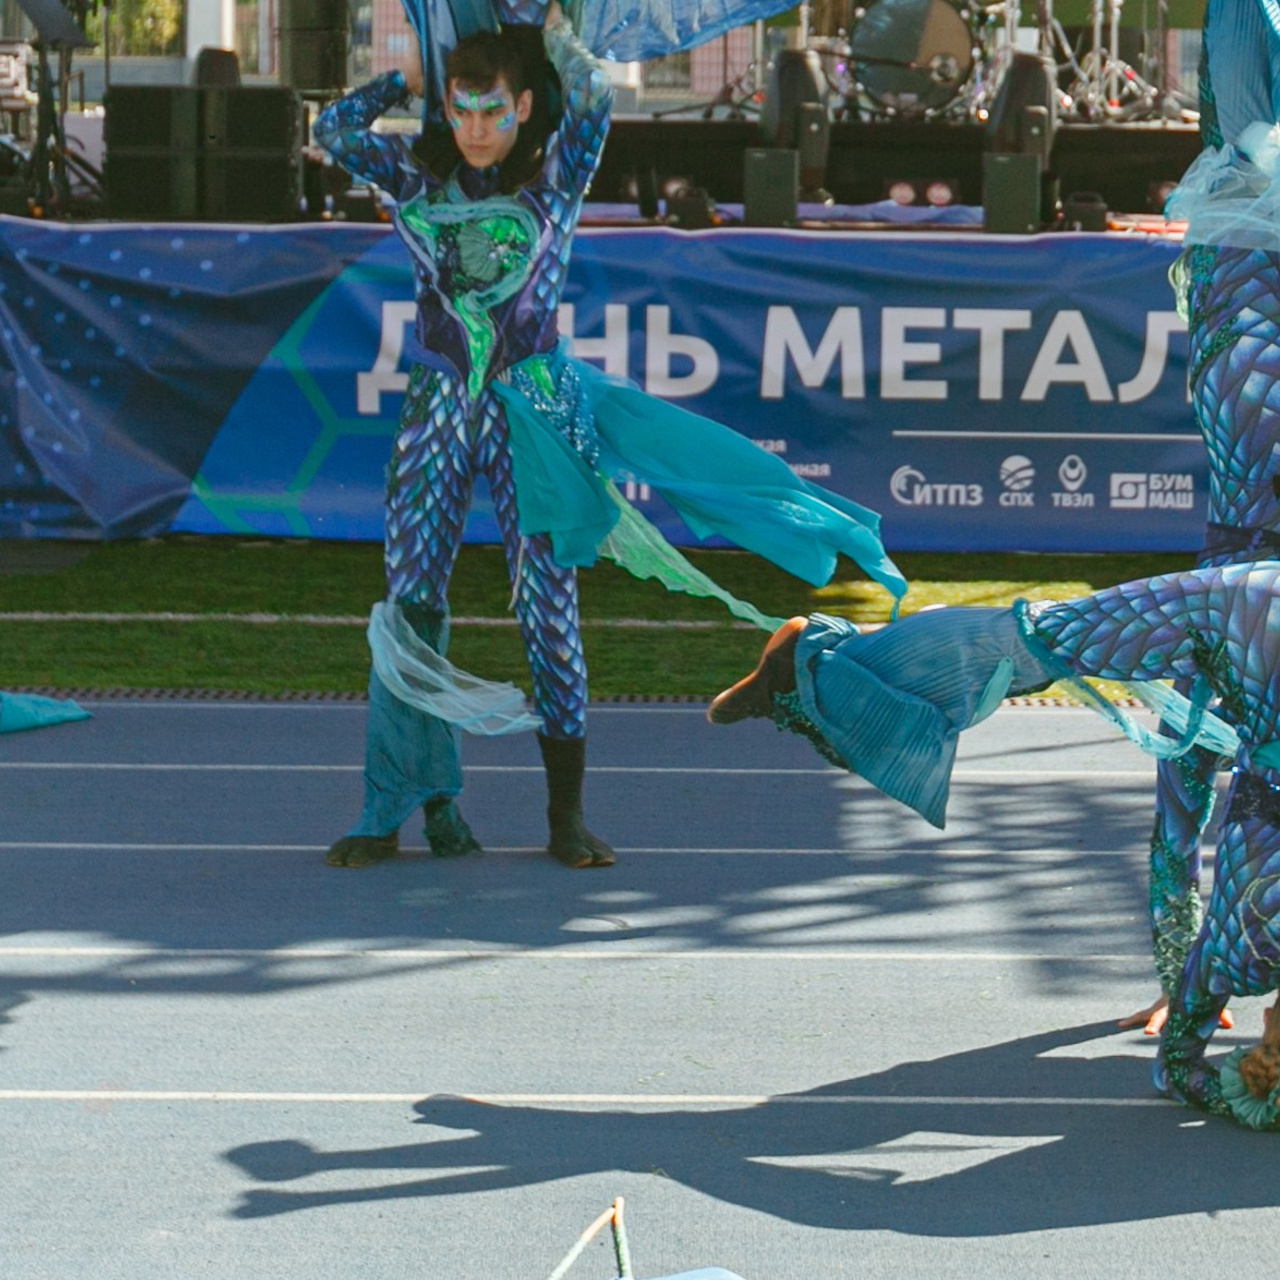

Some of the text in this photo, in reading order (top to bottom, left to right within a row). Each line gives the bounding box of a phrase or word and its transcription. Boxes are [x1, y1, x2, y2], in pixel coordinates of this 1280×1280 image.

[356, 300, 720, 415] ДНЬ
[1149, 473, 1194, 491] БУМ
[999, 491, 1035, 507] СПХ
[1051, 492, 1095, 508] ТВЭЛ
[1149, 491, 1194, 508] МАШ
